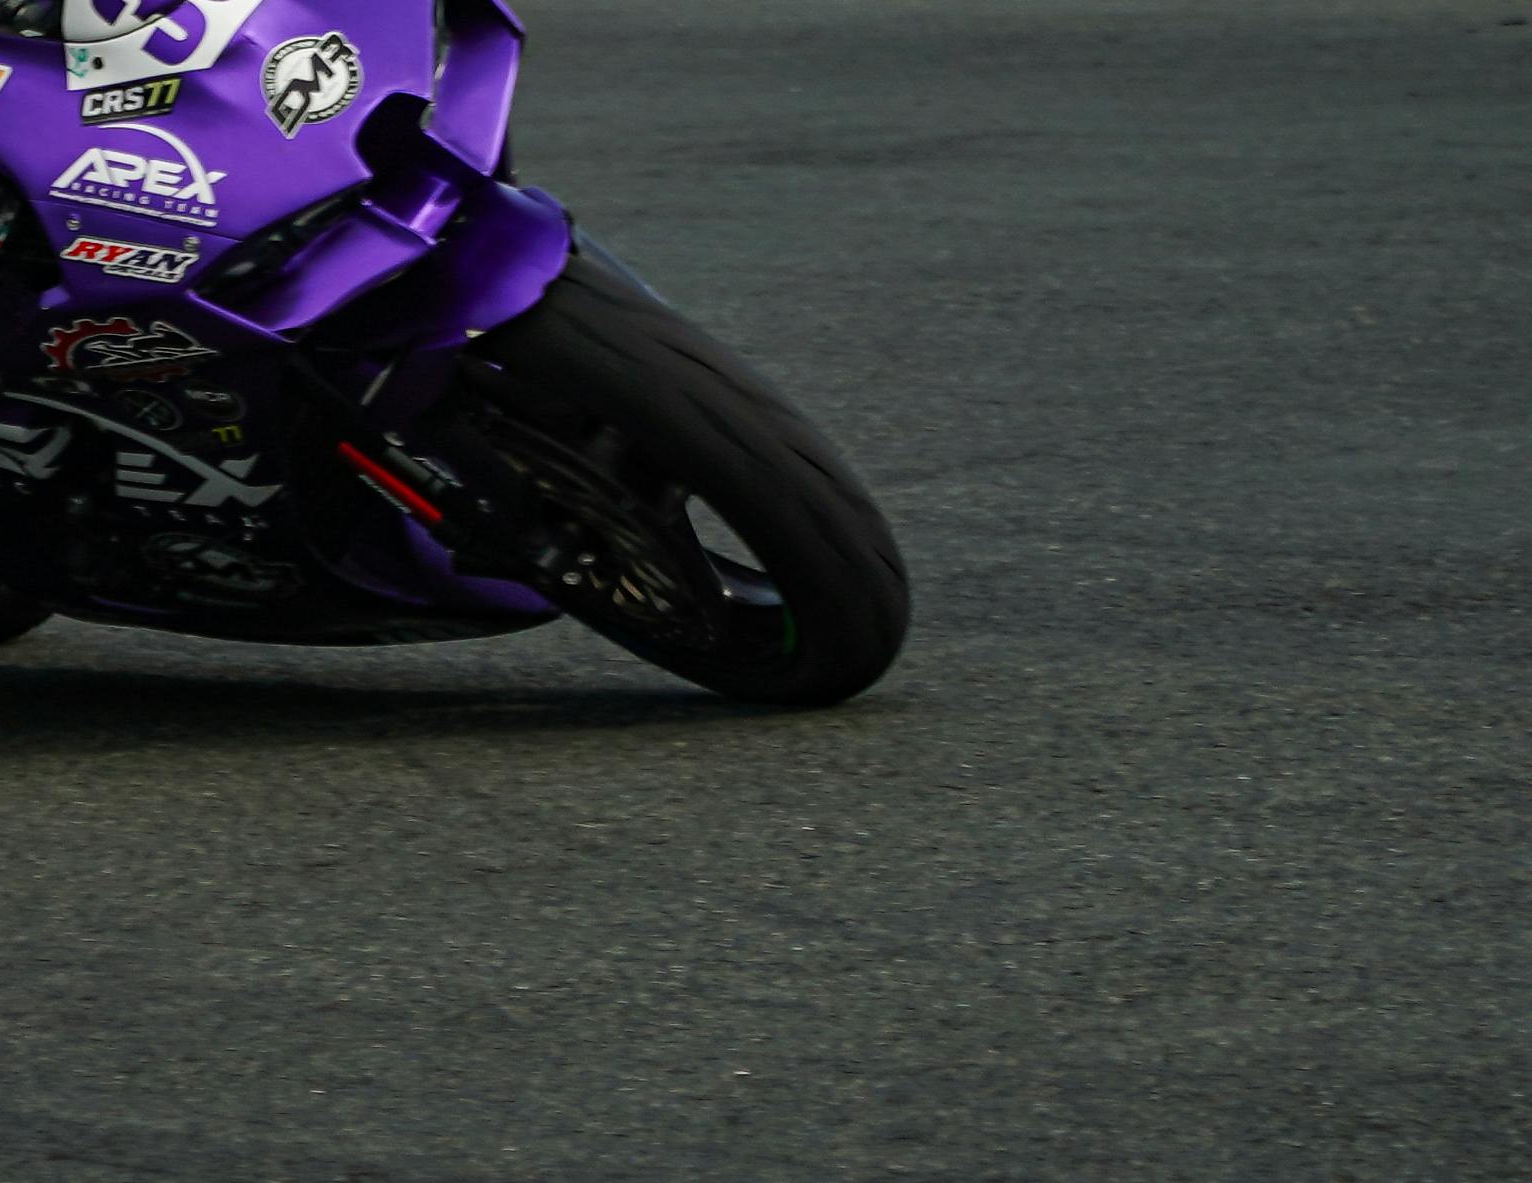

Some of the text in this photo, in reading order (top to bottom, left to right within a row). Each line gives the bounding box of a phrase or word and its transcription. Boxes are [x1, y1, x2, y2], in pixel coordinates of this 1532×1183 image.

[81, 78, 181, 118] CRS77
[50, 124, 229, 205] APEX
[66, 240, 194, 271] RYAN
